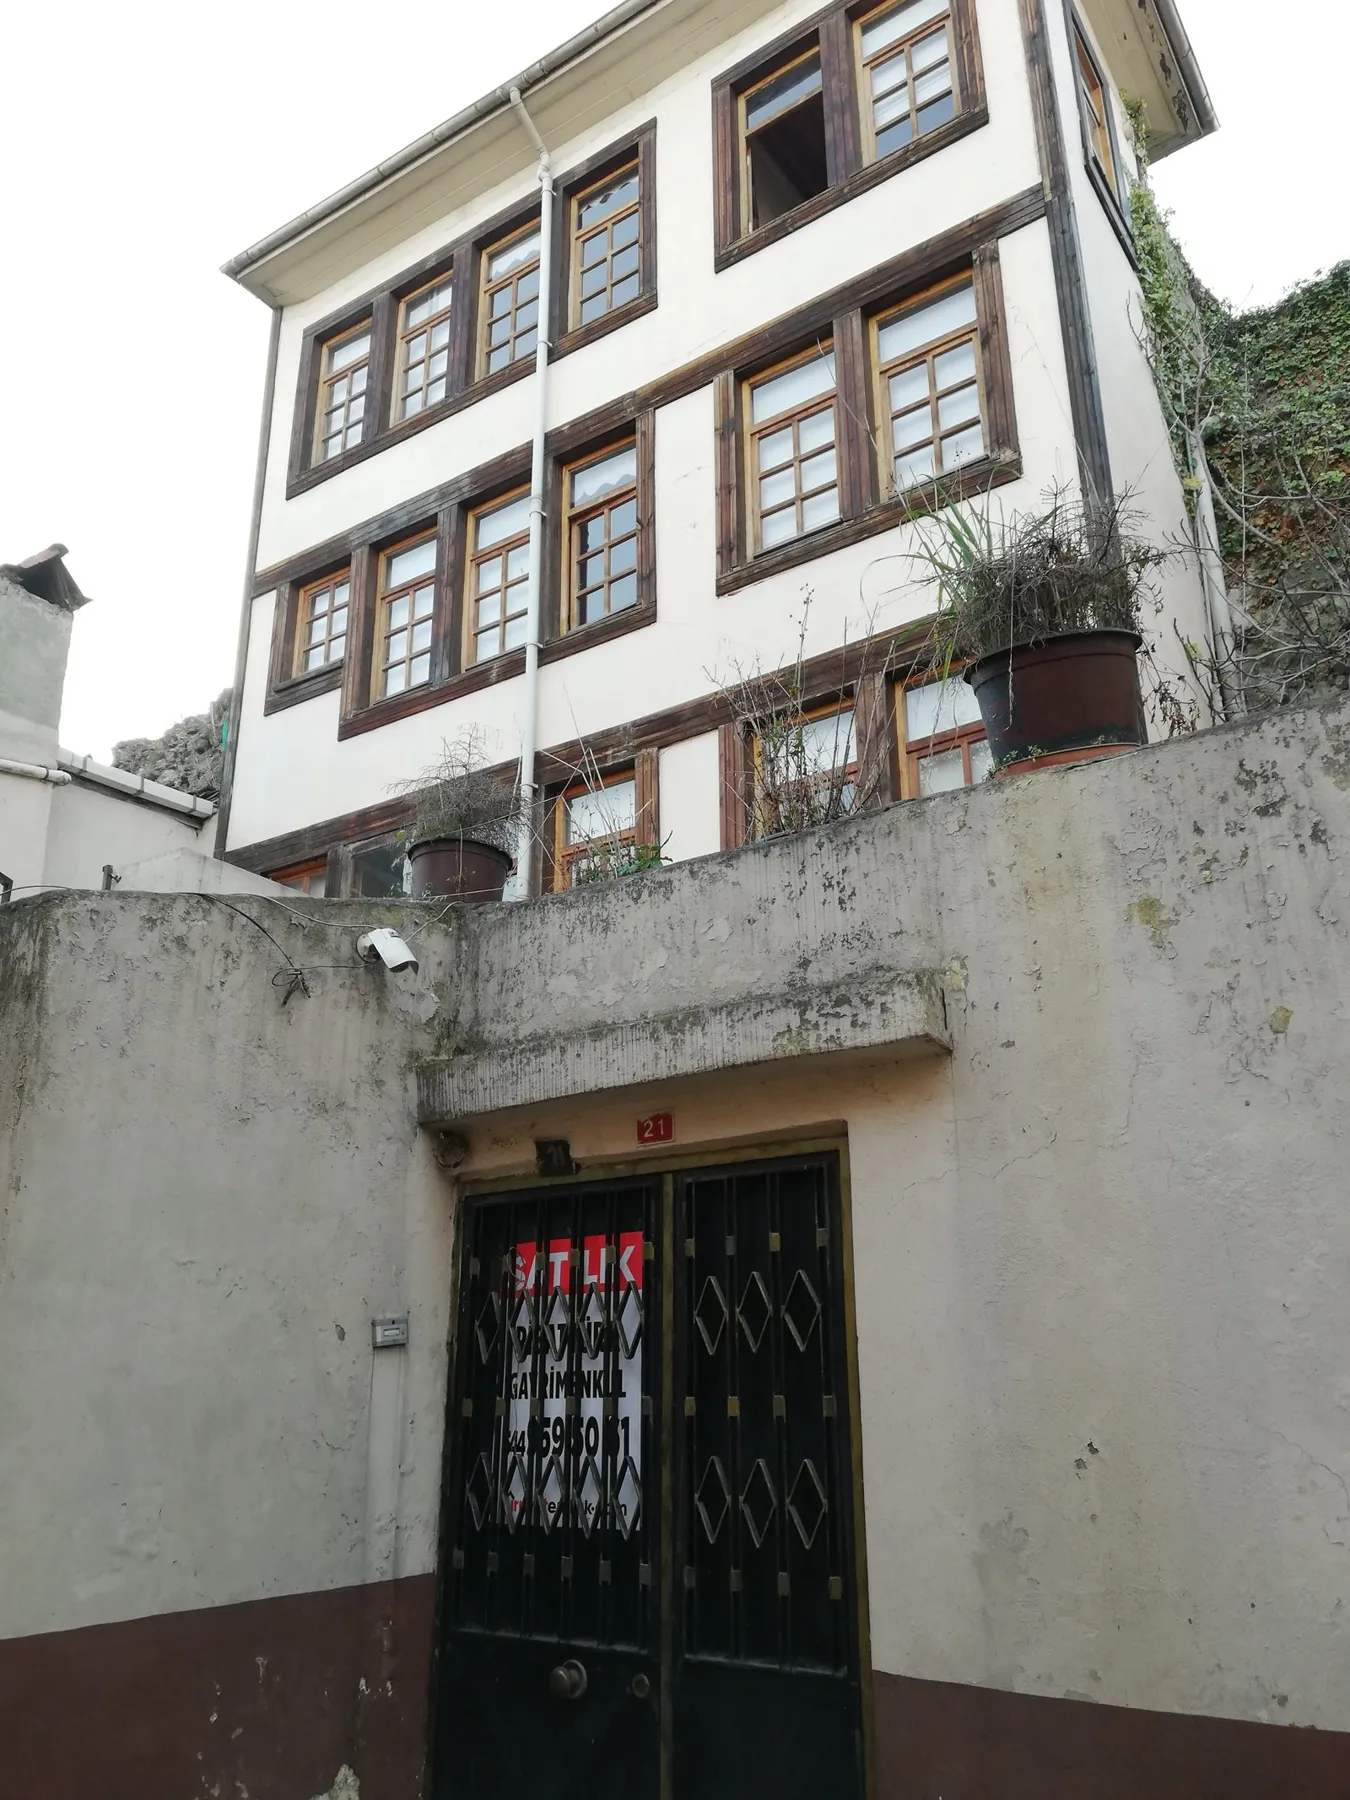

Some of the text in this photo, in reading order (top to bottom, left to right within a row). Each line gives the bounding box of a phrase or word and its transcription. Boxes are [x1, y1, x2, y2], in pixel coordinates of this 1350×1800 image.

[643, 1119, 665, 1138] 21
[507, 1245, 635, 1291] SATLIK
[509, 1366, 626, 1399] GARİMNKL
